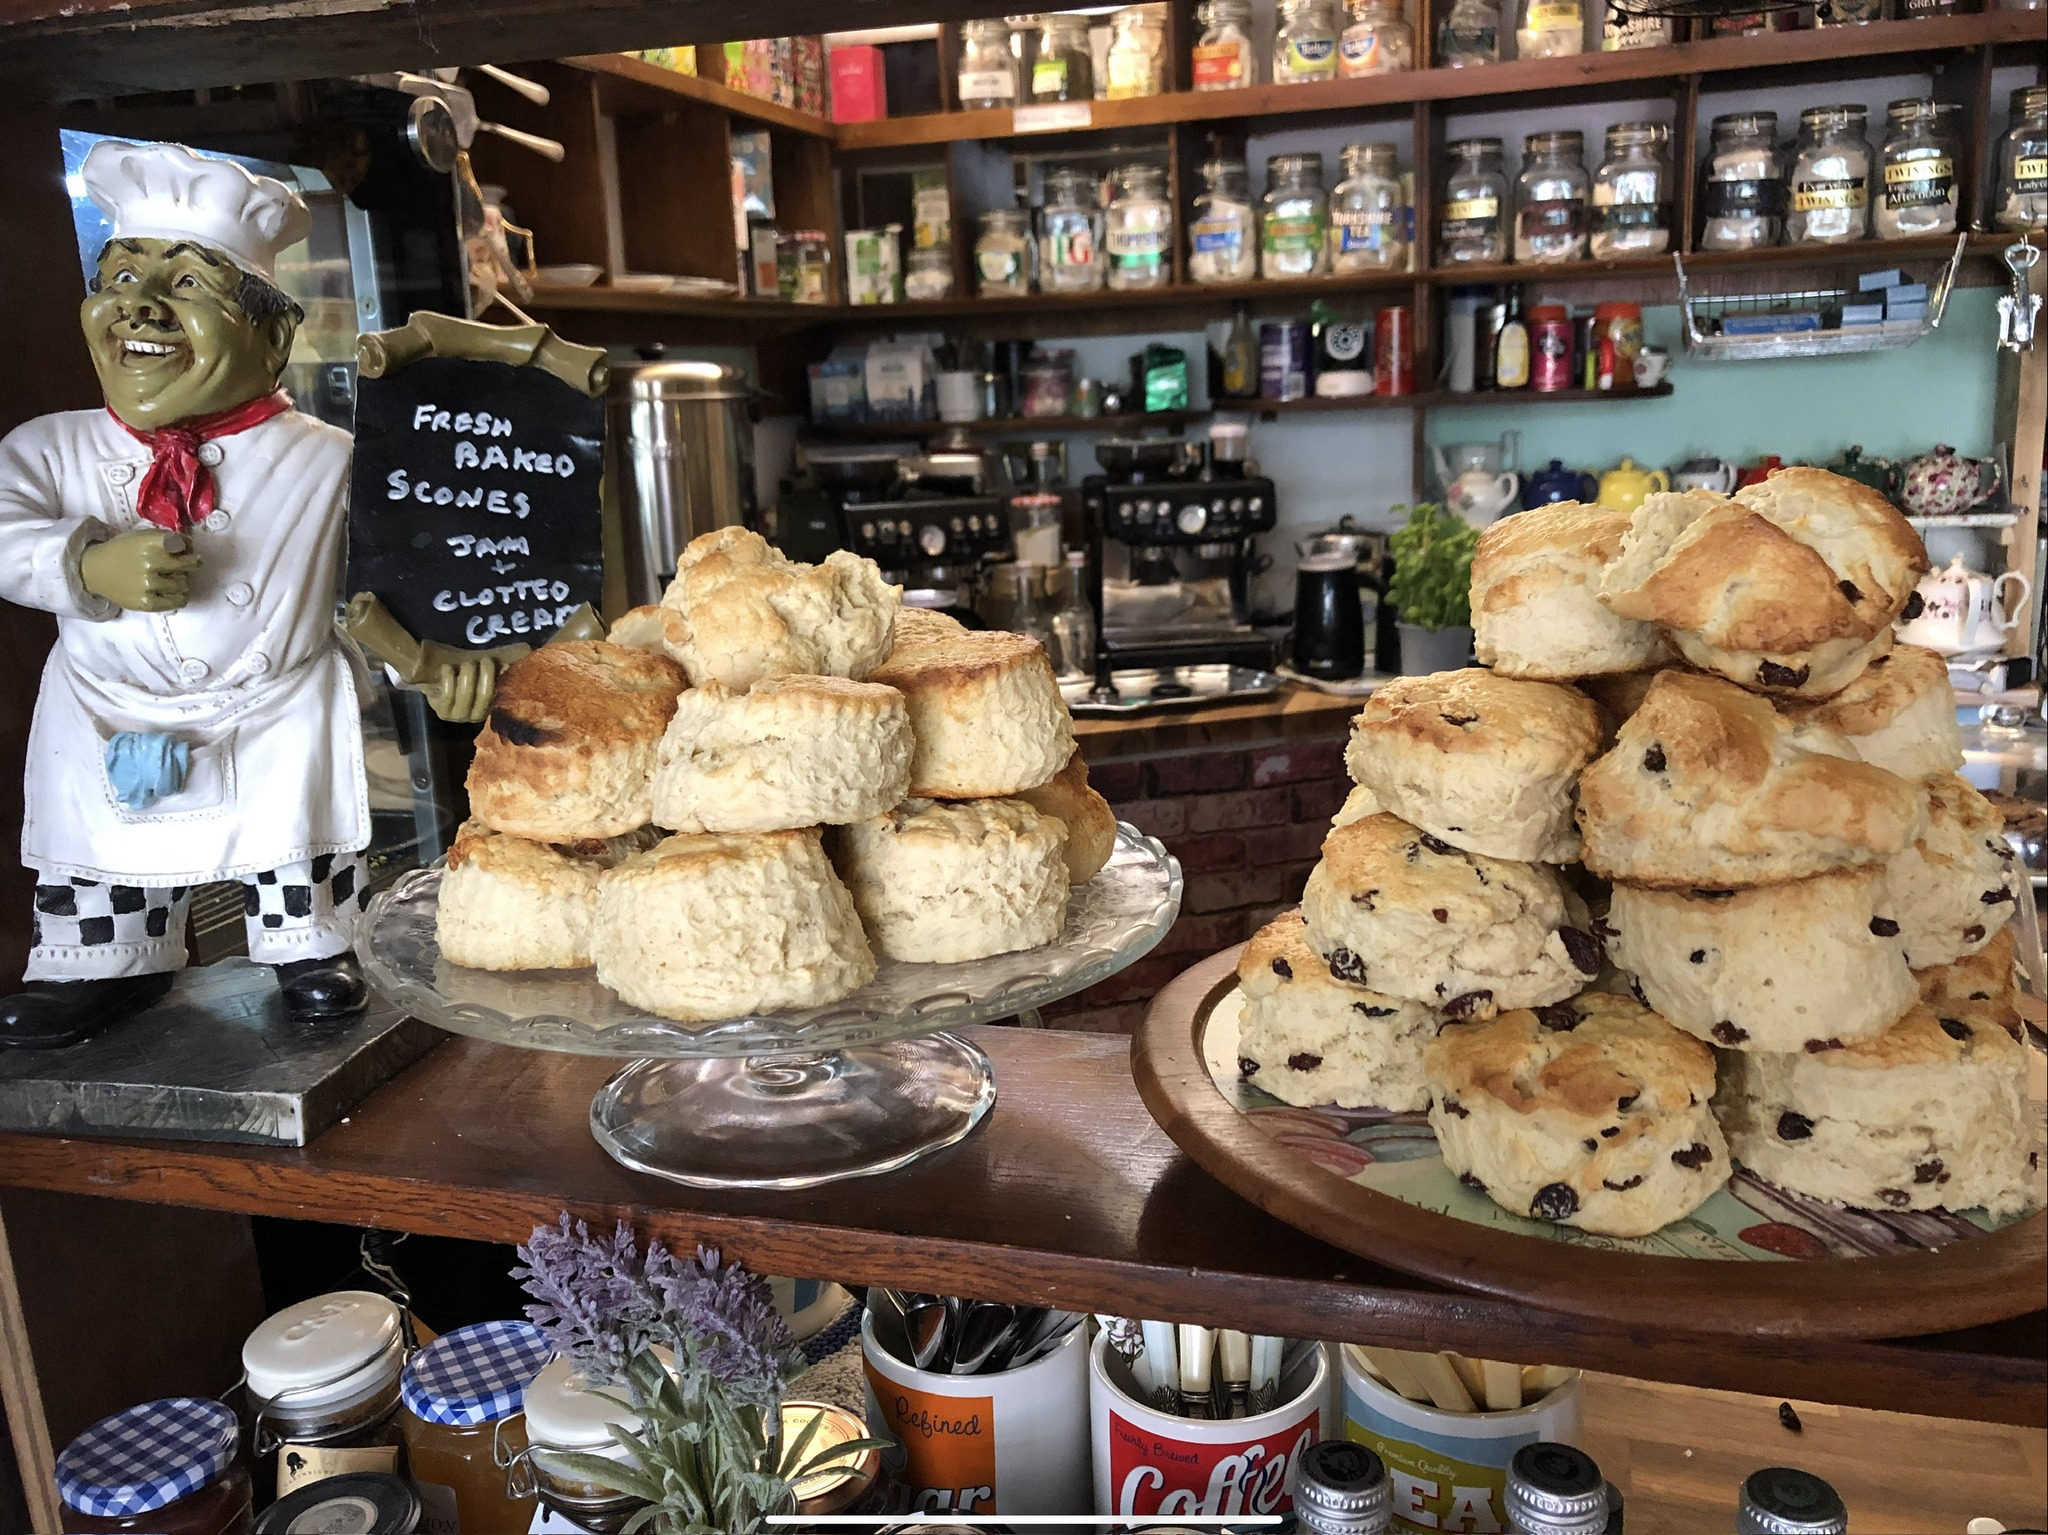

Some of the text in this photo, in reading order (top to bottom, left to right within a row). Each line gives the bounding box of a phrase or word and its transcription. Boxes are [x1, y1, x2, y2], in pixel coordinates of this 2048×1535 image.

[2018, 162, 2047, 175] TWI
[1889, 186, 1946, 205] Afternoon
[413, 404, 512, 437] FRESH
[454, 440, 575, 478] BAKED
[387, 469, 531, 519] SCONES
[446, 534, 530, 558] JAM
[433, 578, 570, 612] CLOTTED
[895, 1396, 982, 1438] Refined
[1115, 1422, 1200, 1465] Freshly Brewed
[1377, 1442, 1457, 1481] Premium Quality
[1390, 1467, 1504, 1533] EA
